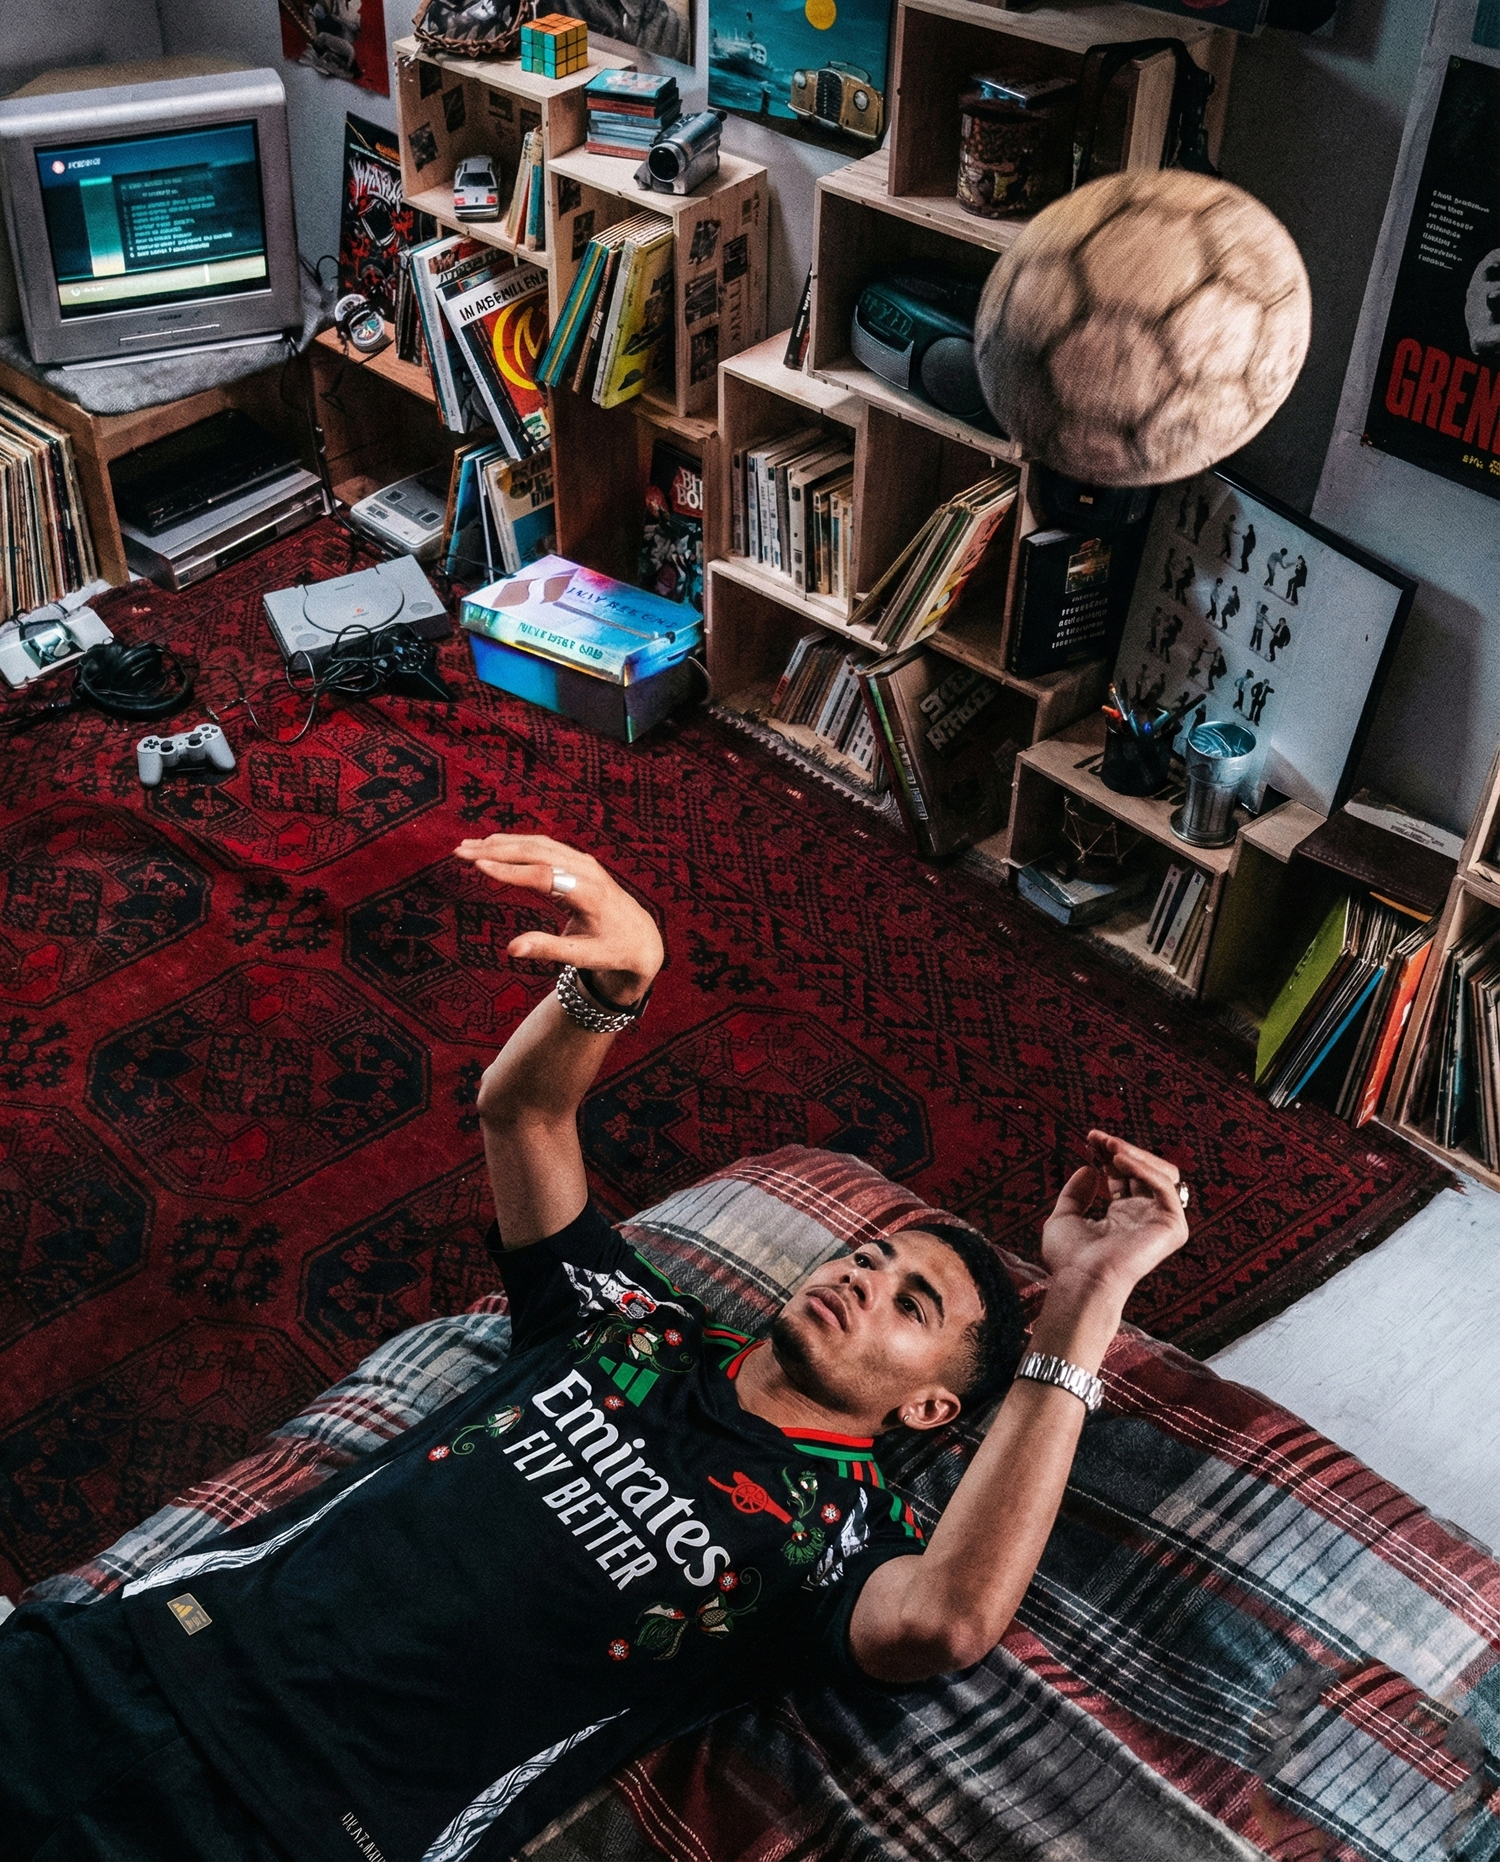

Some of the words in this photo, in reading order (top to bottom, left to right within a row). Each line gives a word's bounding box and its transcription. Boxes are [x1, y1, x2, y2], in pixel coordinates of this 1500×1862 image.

[1385, 337, 1500, 456] GREN
[502, 1429, 574, 1482] FLY
[541, 1476, 658, 1591] BETTER
[531, 1368, 731, 1587] Emirates
